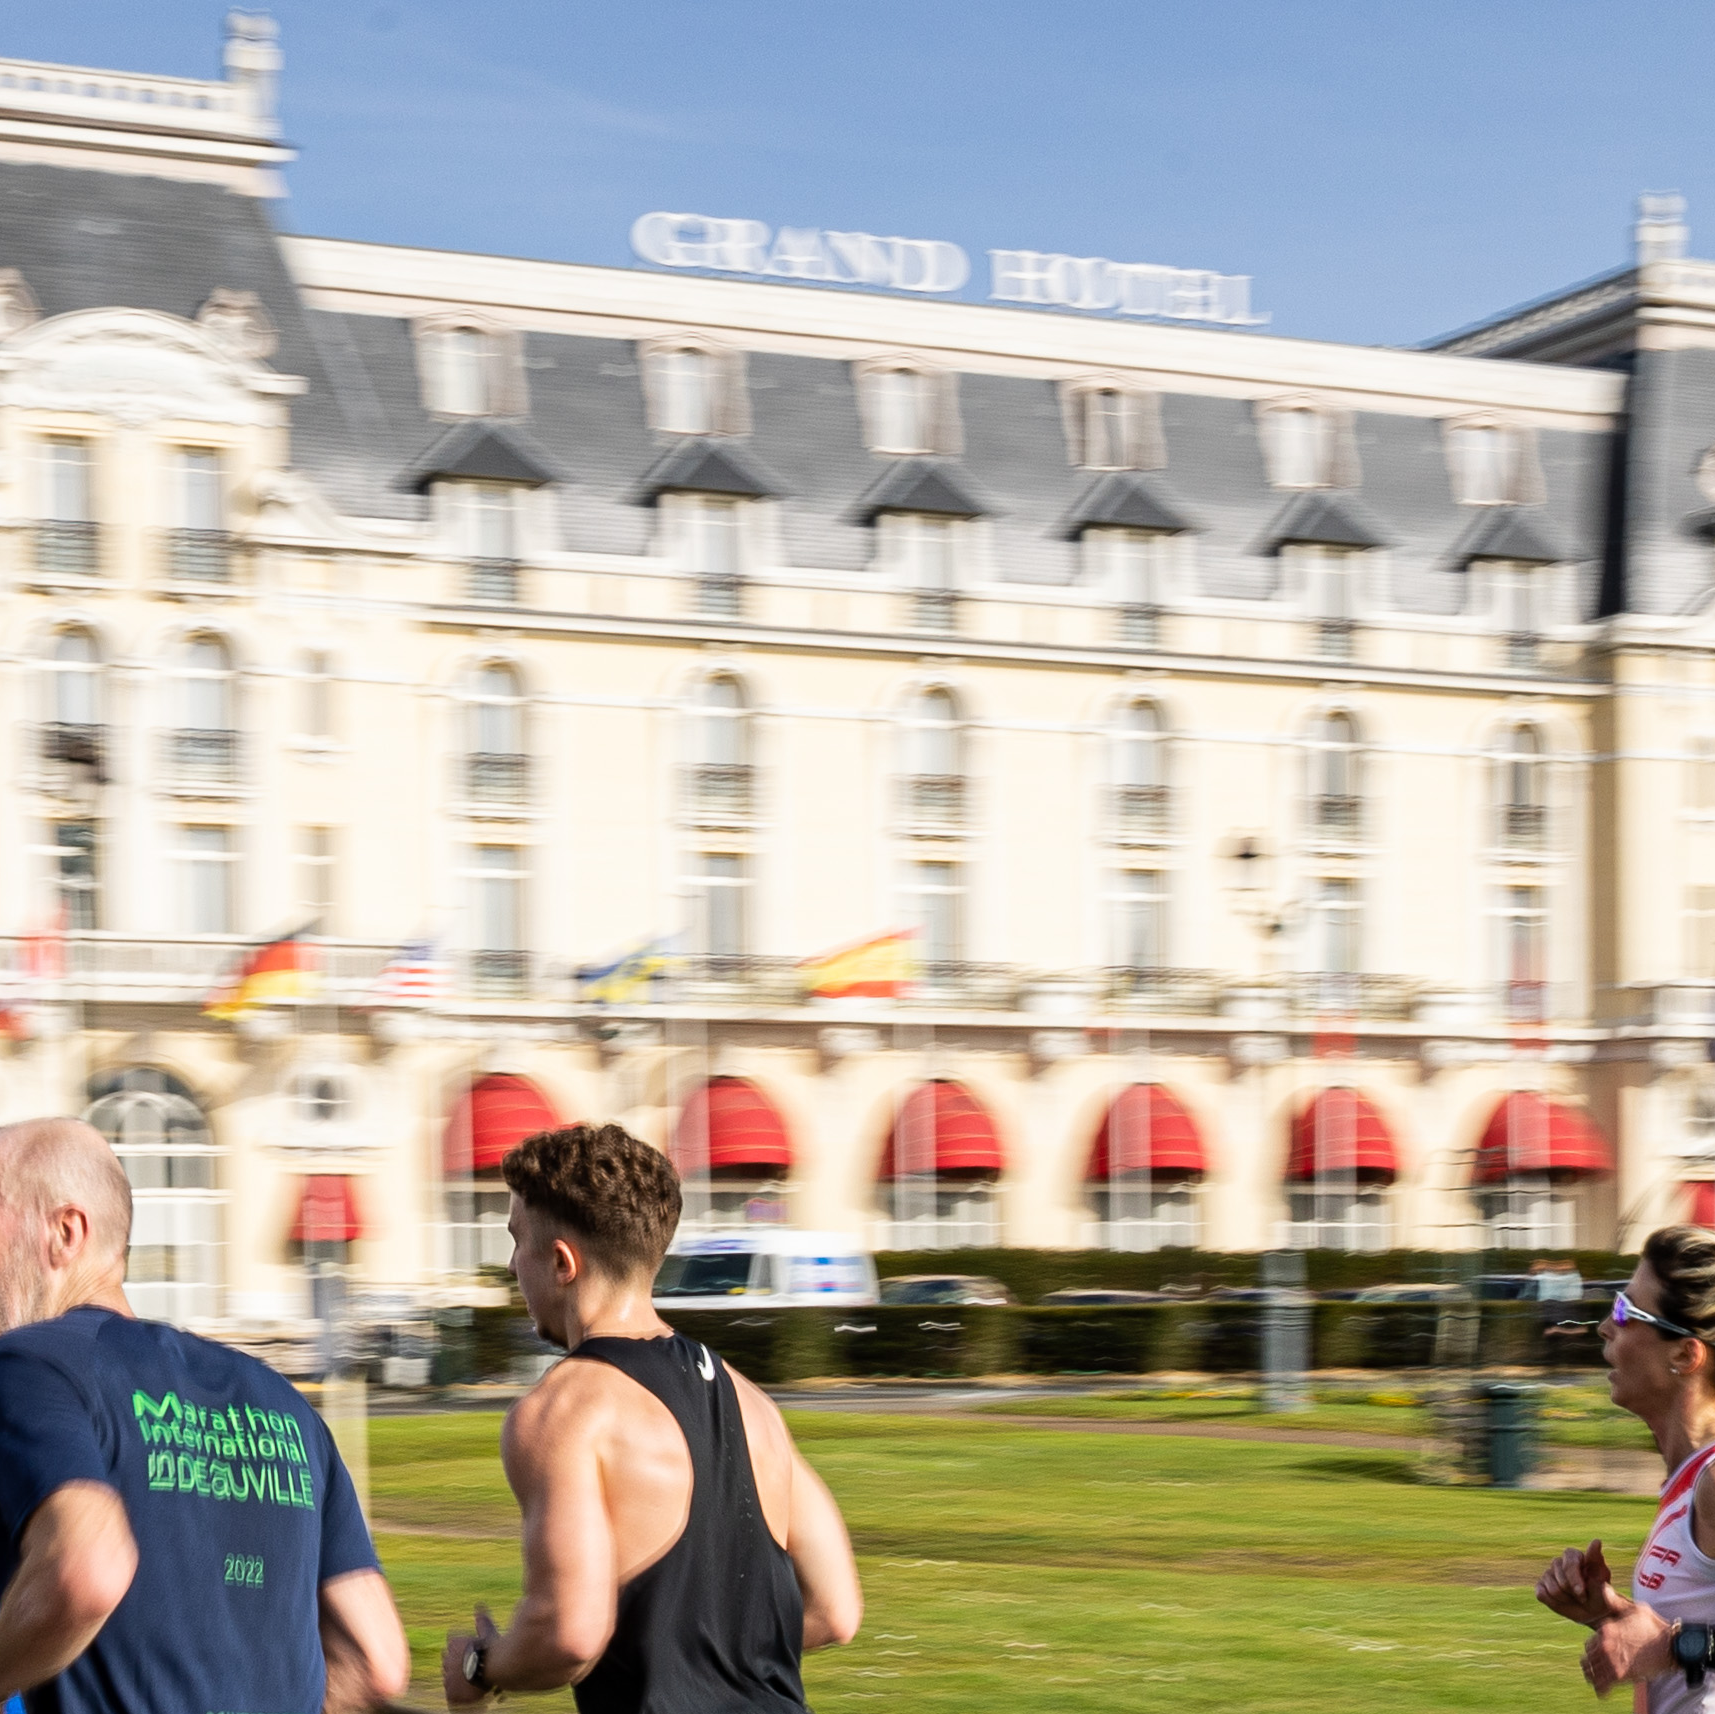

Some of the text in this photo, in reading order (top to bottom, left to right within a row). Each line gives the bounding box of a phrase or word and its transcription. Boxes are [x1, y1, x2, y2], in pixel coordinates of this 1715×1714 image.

[631, 210, 1271, 325] GRAND HOTEL
[132, 1389, 300, 1434] Marathon
[139, 1416, 308, 1465] International
[224, 1553, 264, 1588] 2022
